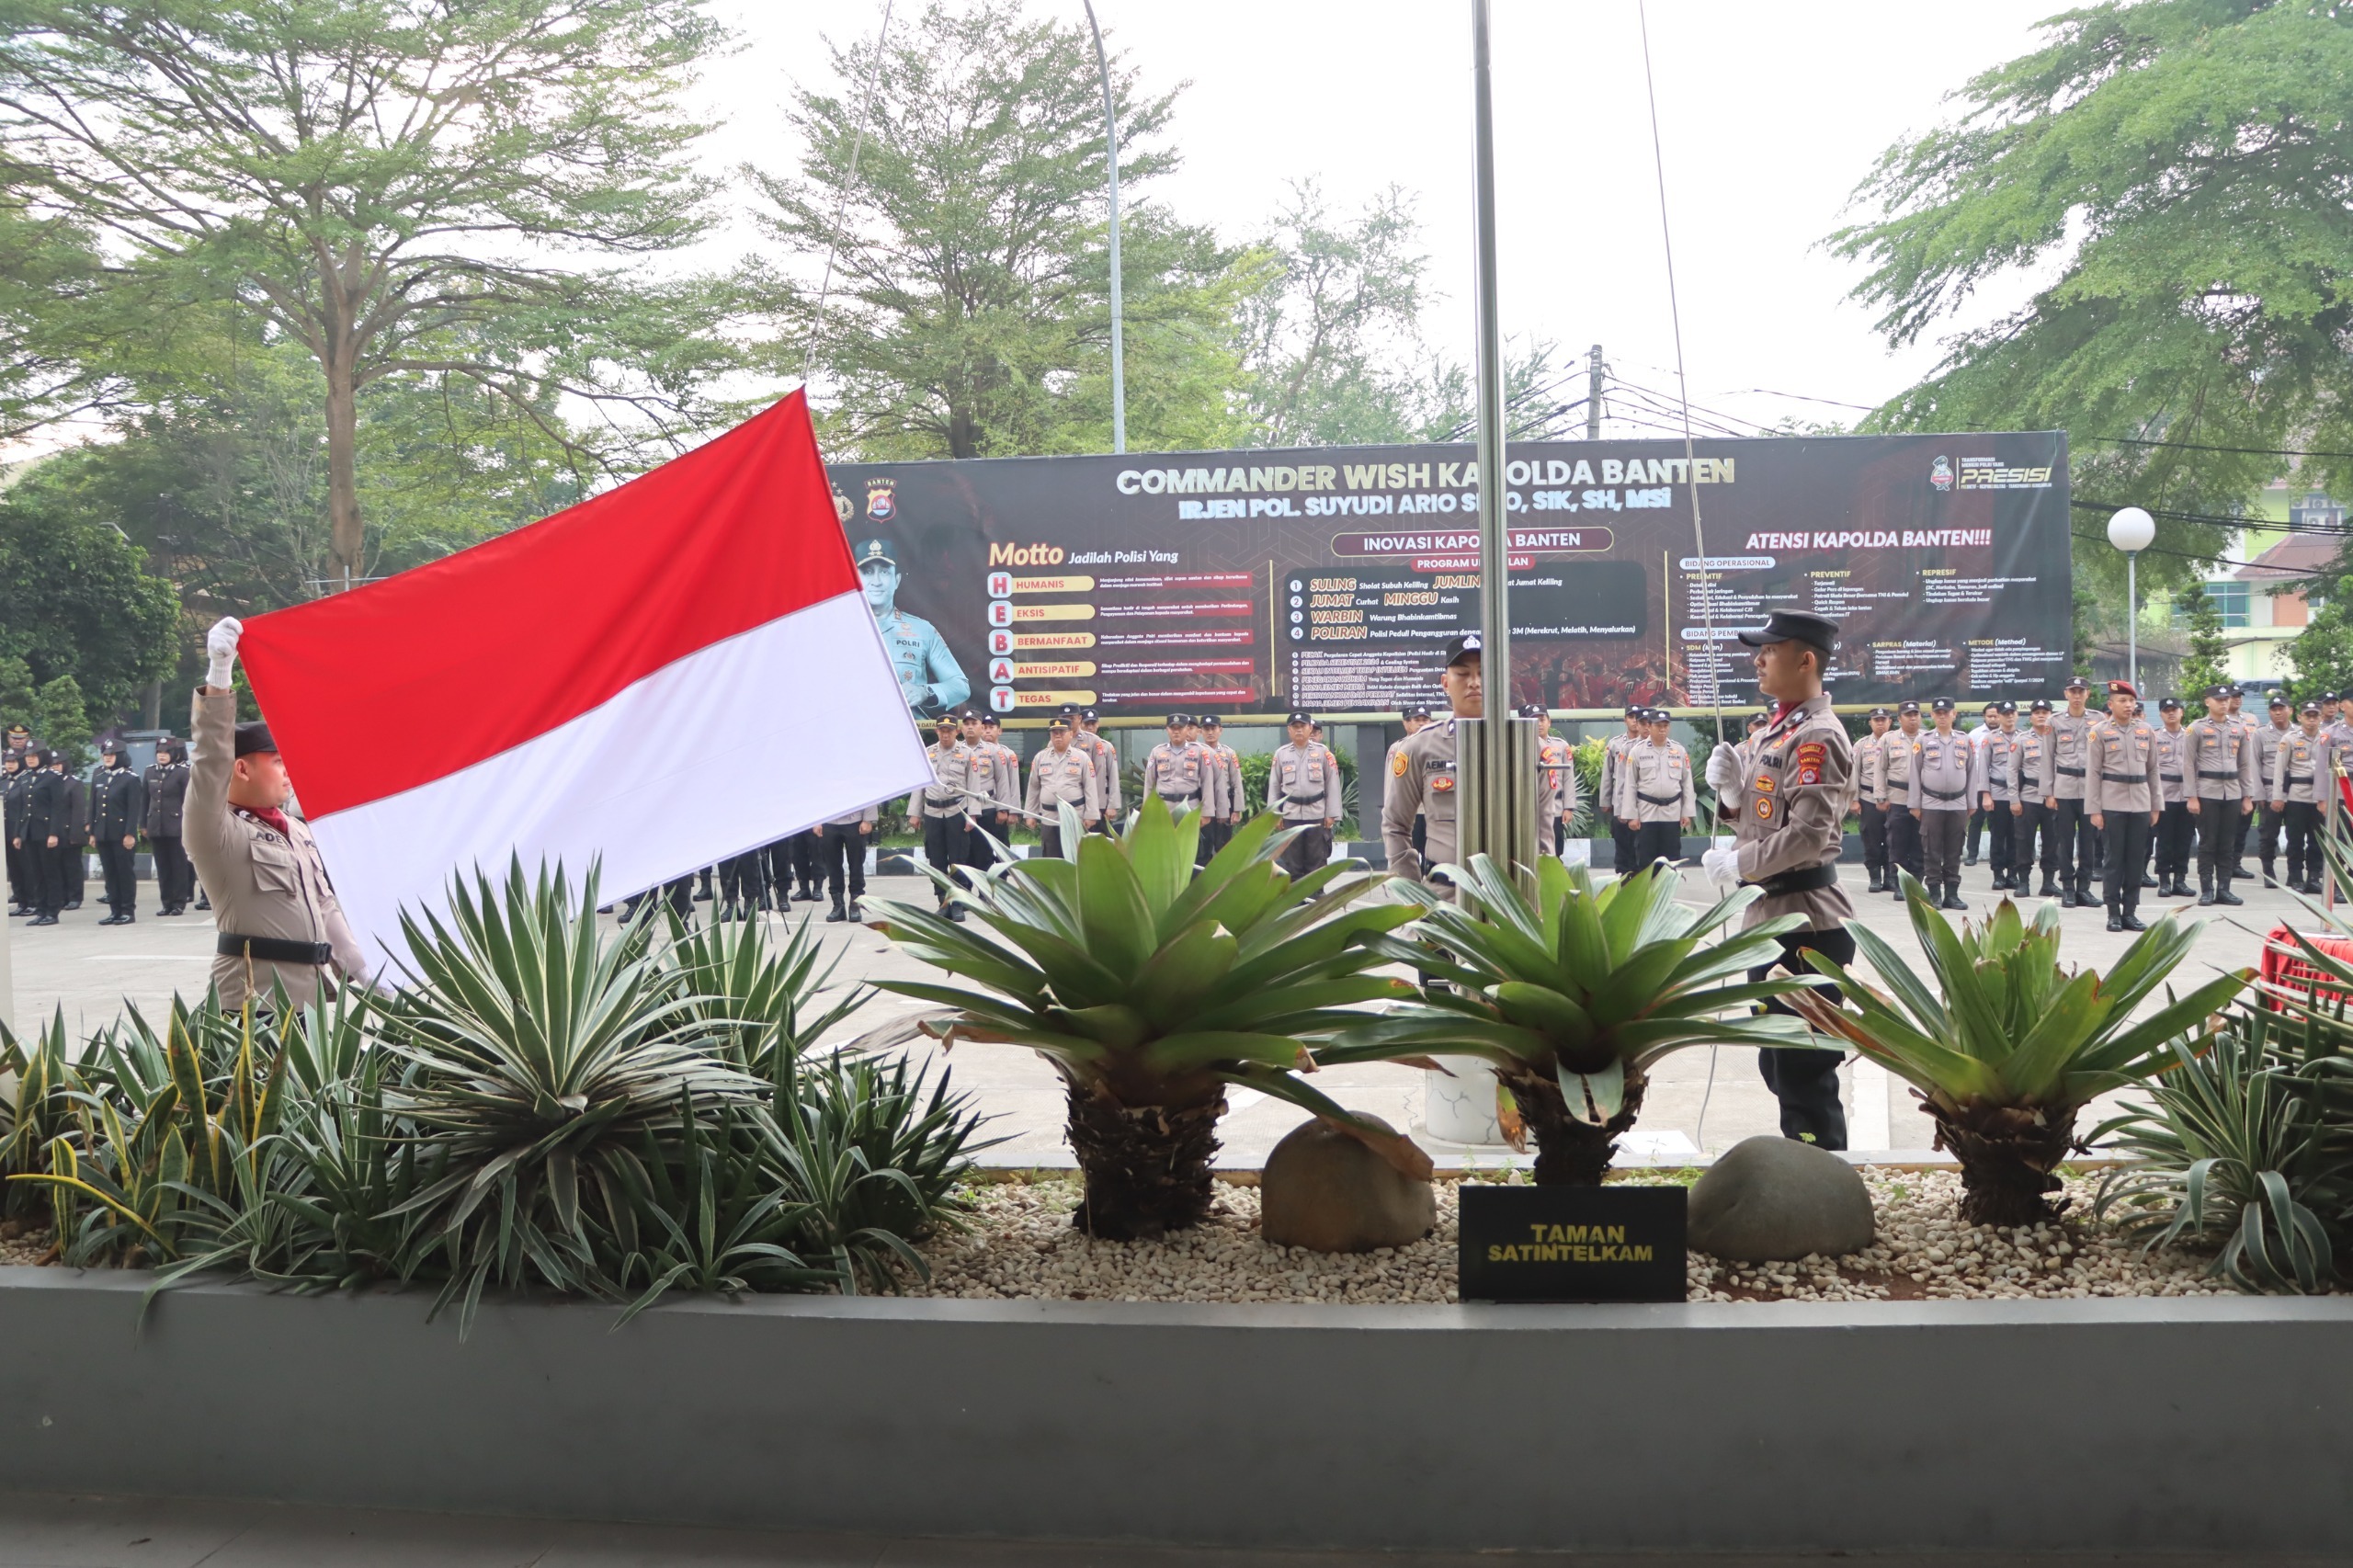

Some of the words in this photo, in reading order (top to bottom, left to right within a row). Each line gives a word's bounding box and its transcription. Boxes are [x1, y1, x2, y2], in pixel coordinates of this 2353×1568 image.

[867, 478, 896, 487] BANTEN
[1116, 465, 1336, 495] COMMANDER
[1343, 462, 1430, 490] WISH
[1438, 459, 1596, 487] KAOLDA
[1602, 458, 1734, 484] BANTEN
[1961, 467, 2052, 483] PRESISI
[1249, 498, 1302, 518] POL.
[1305, 495, 1392, 517] SUYUDI
[1398, 494, 1457, 515] ARIO
[1532, 490, 1578, 512] SIK,
[1582, 489, 1622, 511] SH,
[1364, 536, 1431, 551] INOVASI
[1436, 534, 1512, 550] KAPO
[1516, 532, 1581, 548] BANTEN
[1745, 532, 1809, 549] ATENSI
[1813, 530, 1899, 549] KAPOLDA
[1902, 529, 1992, 547] BANTEN!!!
[988, 542, 1063, 567] Motto
[1068, 551, 1112, 564] Jadilah
[1114, 551, 1146, 563] Polisi
[1148, 550, 1178, 564] Yang
[1417, 559, 1469, 568] PROGRAM
[993, 576, 1007, 595] H
[1016, 580, 1064, 590] HUMANIS
[1310, 578, 1357, 592] SULING
[1404, 581, 1428, 589] Keliling
[1433, 575, 1481, 589] JUMLIN
[1537, 578, 1563, 586] Keliling
[1310, 594, 1354, 608] JUMAT
[1384, 592, 1438, 606] MINGGU
[995, 606, 1006, 622] E
[1017, 608, 1045, 618] EKSIS
[1311, 610, 1363, 623] WARBIN
[1370, 614, 1396, 622] Warung
[1397, 613, 1457, 621] Bhabinkamtibmas
[1311, 626, 1368, 640] POLIRAN
[1411, 630, 1458, 638] Pengangguran
[1525, 627, 1560, 635] (Merekrut,
[1561, 626, 1588, 634] Melatih,
[1589, 625, 1636, 634] Menyalurkan)
[896, 639, 920, 648] POLRI
[995, 634, 1007, 652] B
[1017, 636, 1087, 646] BERMANFAAT
[1903, 639, 1937, 648] (Material)
[1995, 638, 2027, 646] (Method)
[994, 662, 1010, 679] A
[1017, 665, 1080, 676] ANTISIPATIF
[996, 690, 1009, 708] T
[1018, 693, 1051, 703] TEGAS
[256, 830, 283, 844] ADE
[1530, 1224, 1625, 1244] TAMAN
[1488, 1244, 1653, 1262] SATINTELKAM
